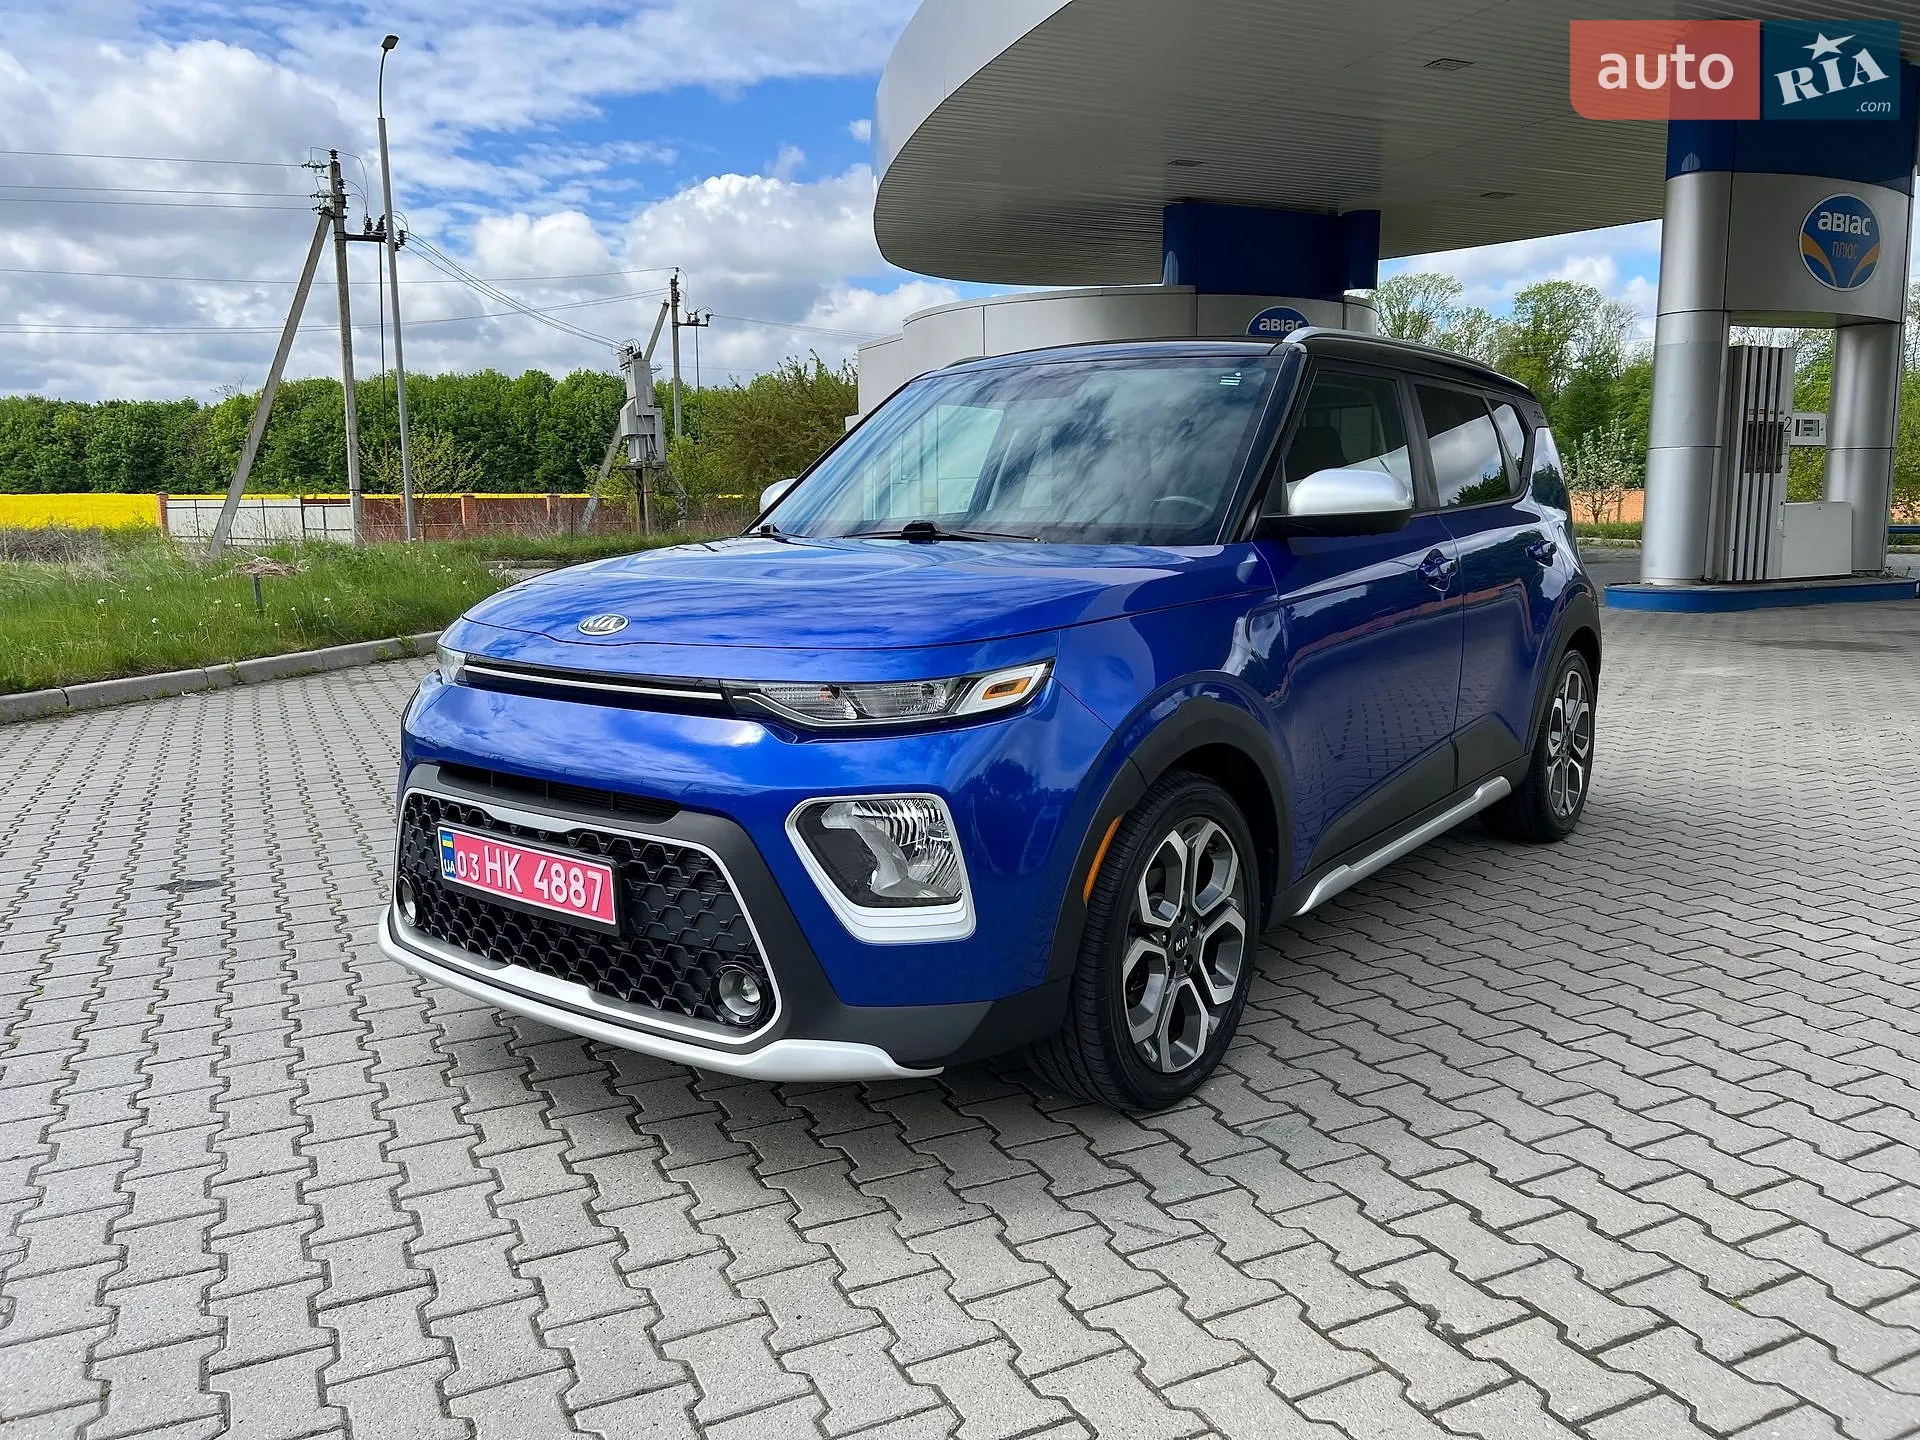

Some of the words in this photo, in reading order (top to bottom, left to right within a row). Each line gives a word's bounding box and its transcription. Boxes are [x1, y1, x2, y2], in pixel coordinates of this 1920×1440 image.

[1784, 416, 1792, 432] 2
[582, 616, 619, 629] KIA
[444, 859, 456, 874] UA
[457, 850, 481, 881] 03
[533, 859, 603, 912] 4887
[1176, 936, 1188, 951] KIA
